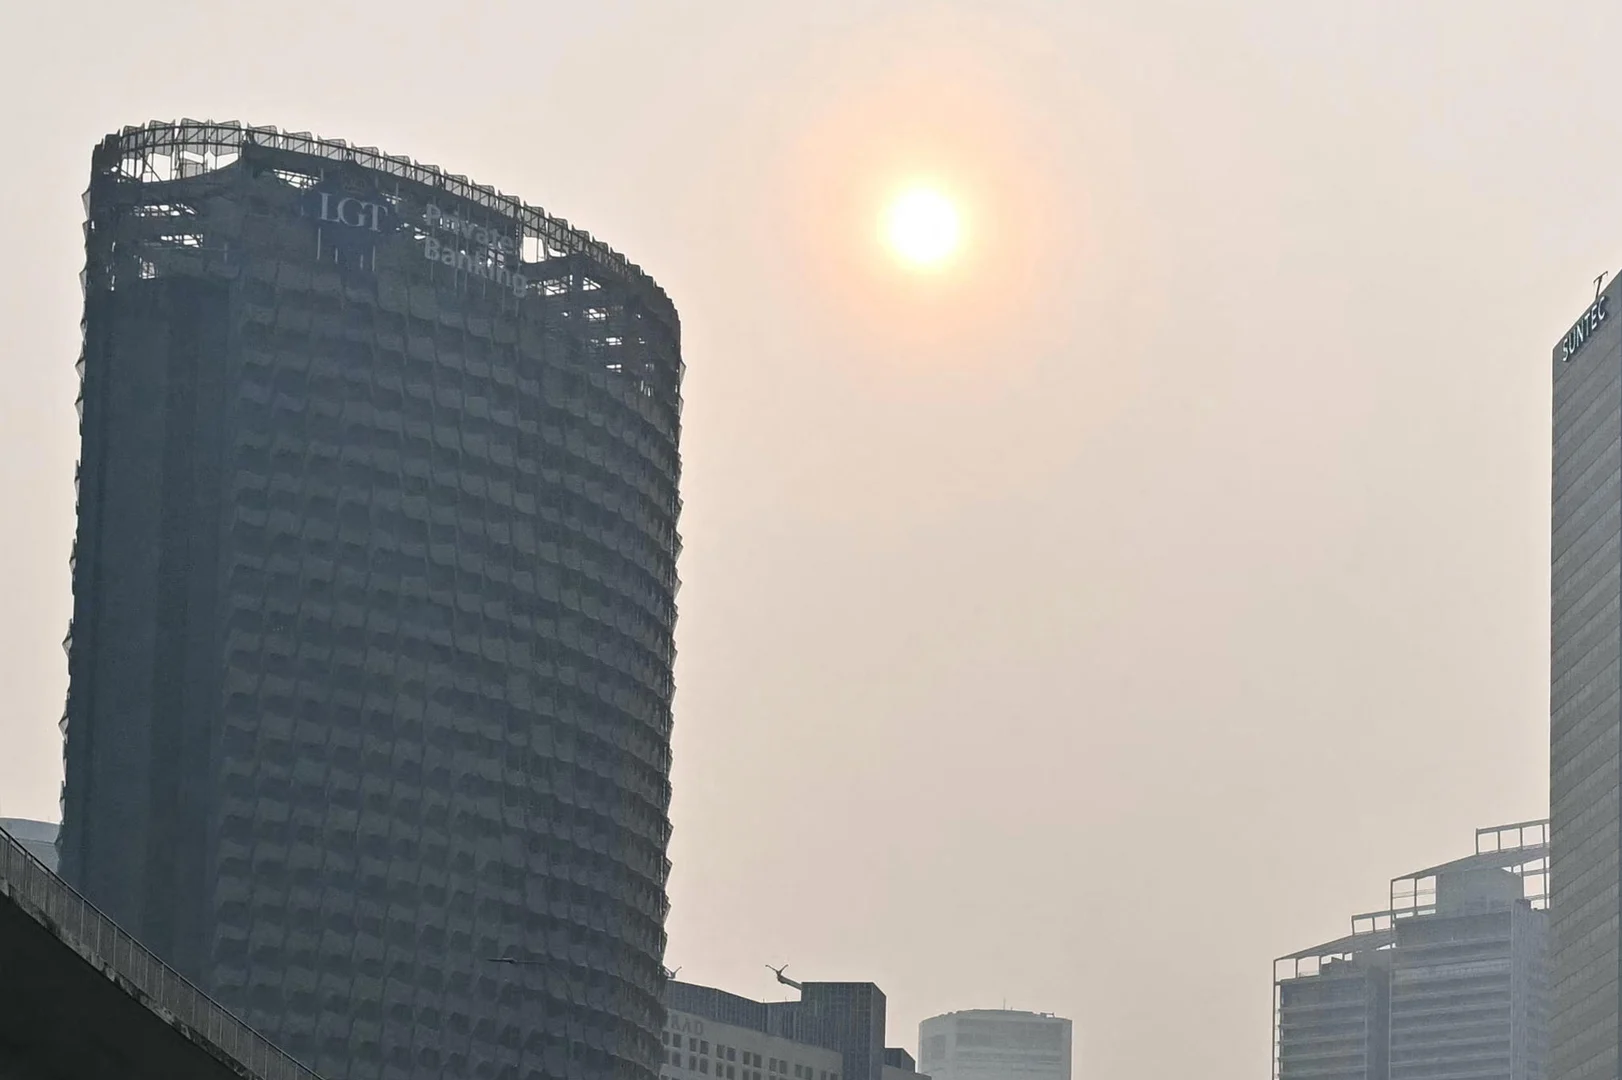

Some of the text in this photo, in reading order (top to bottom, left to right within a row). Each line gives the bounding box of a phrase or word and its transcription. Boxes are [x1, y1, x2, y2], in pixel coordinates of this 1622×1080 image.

[320, 192, 388, 233] LGT
[425, 203, 514, 255] Private
[424, 236, 527, 298] Banking
[1562, 295, 1608, 362] SUNTEC
